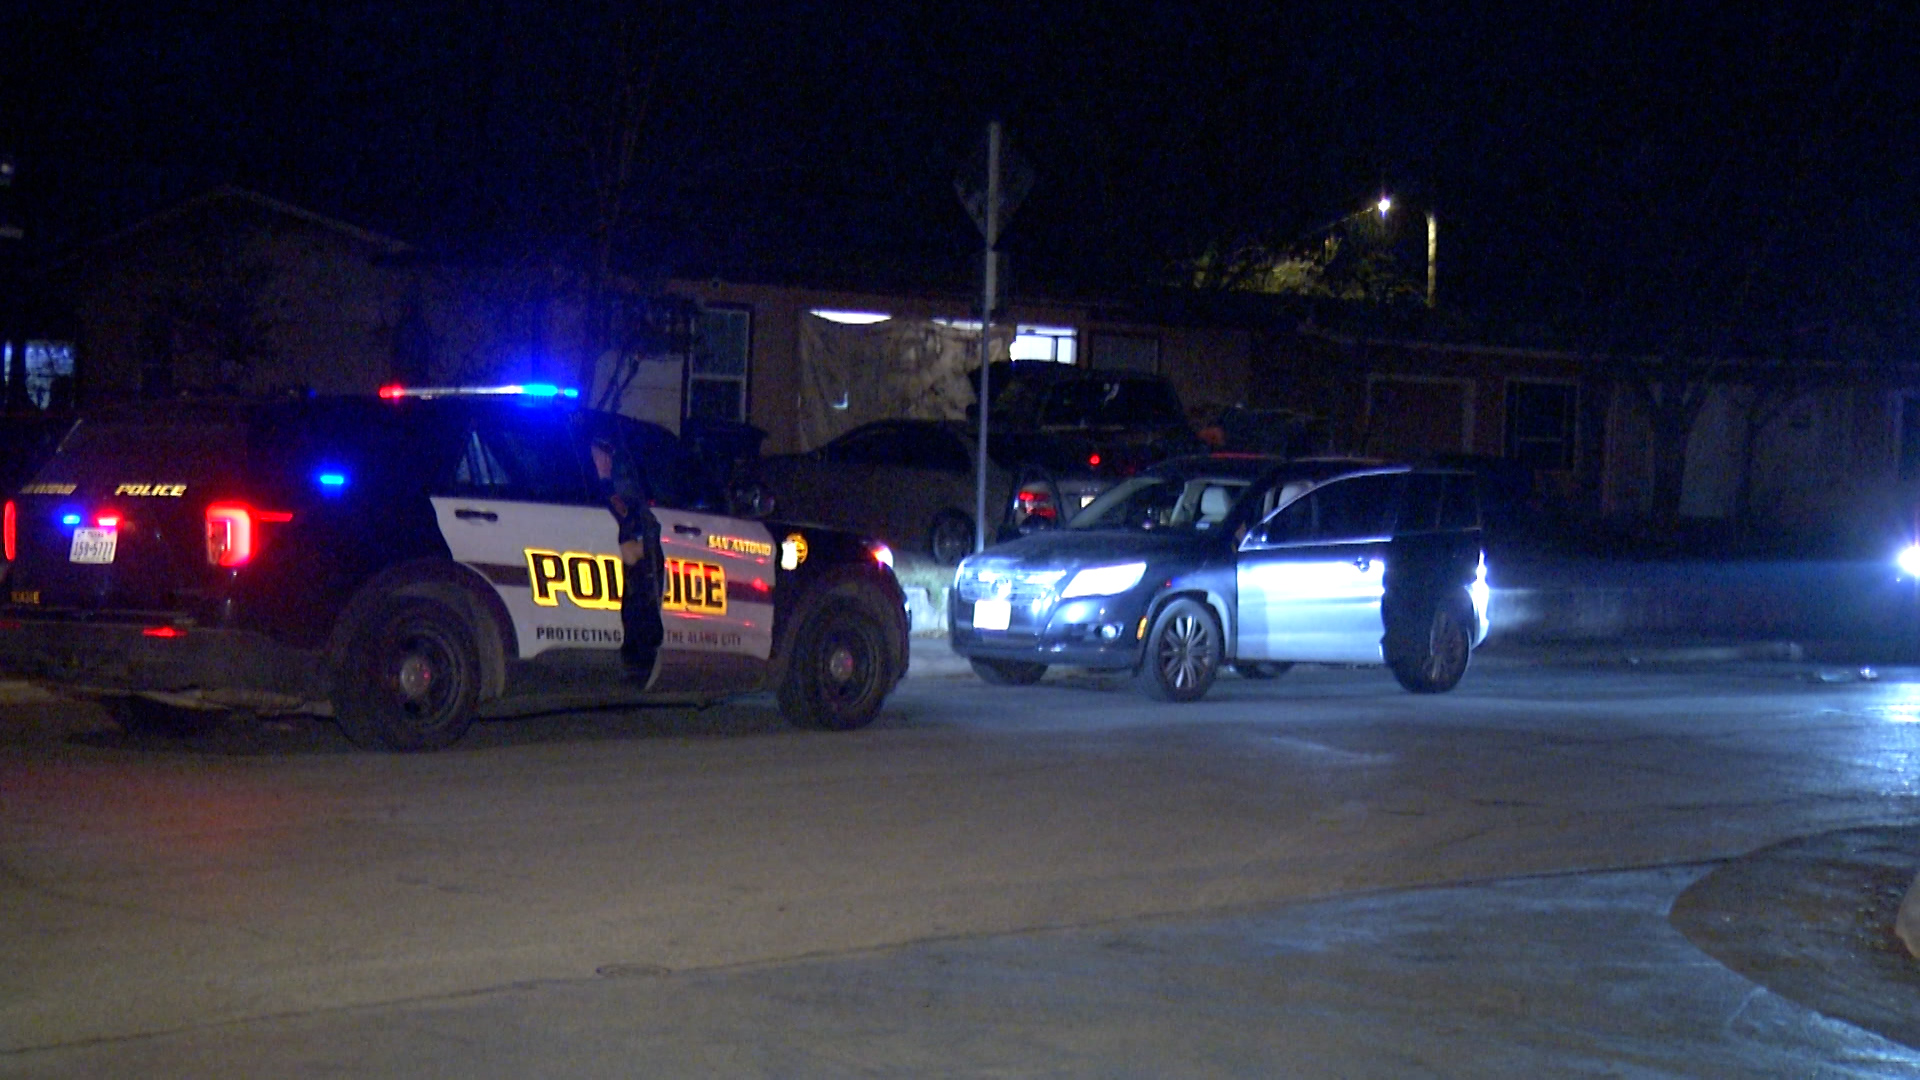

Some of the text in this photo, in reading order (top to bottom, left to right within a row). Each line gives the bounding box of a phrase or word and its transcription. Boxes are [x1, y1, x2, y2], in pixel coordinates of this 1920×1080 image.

[114, 483, 187, 497] POLICE
[708, 535, 772, 556] SAN ANTONIO
[536, 627, 623, 643] PROTECTING
[666, 631, 683, 644] THE
[721, 633, 742, 646] CITY
